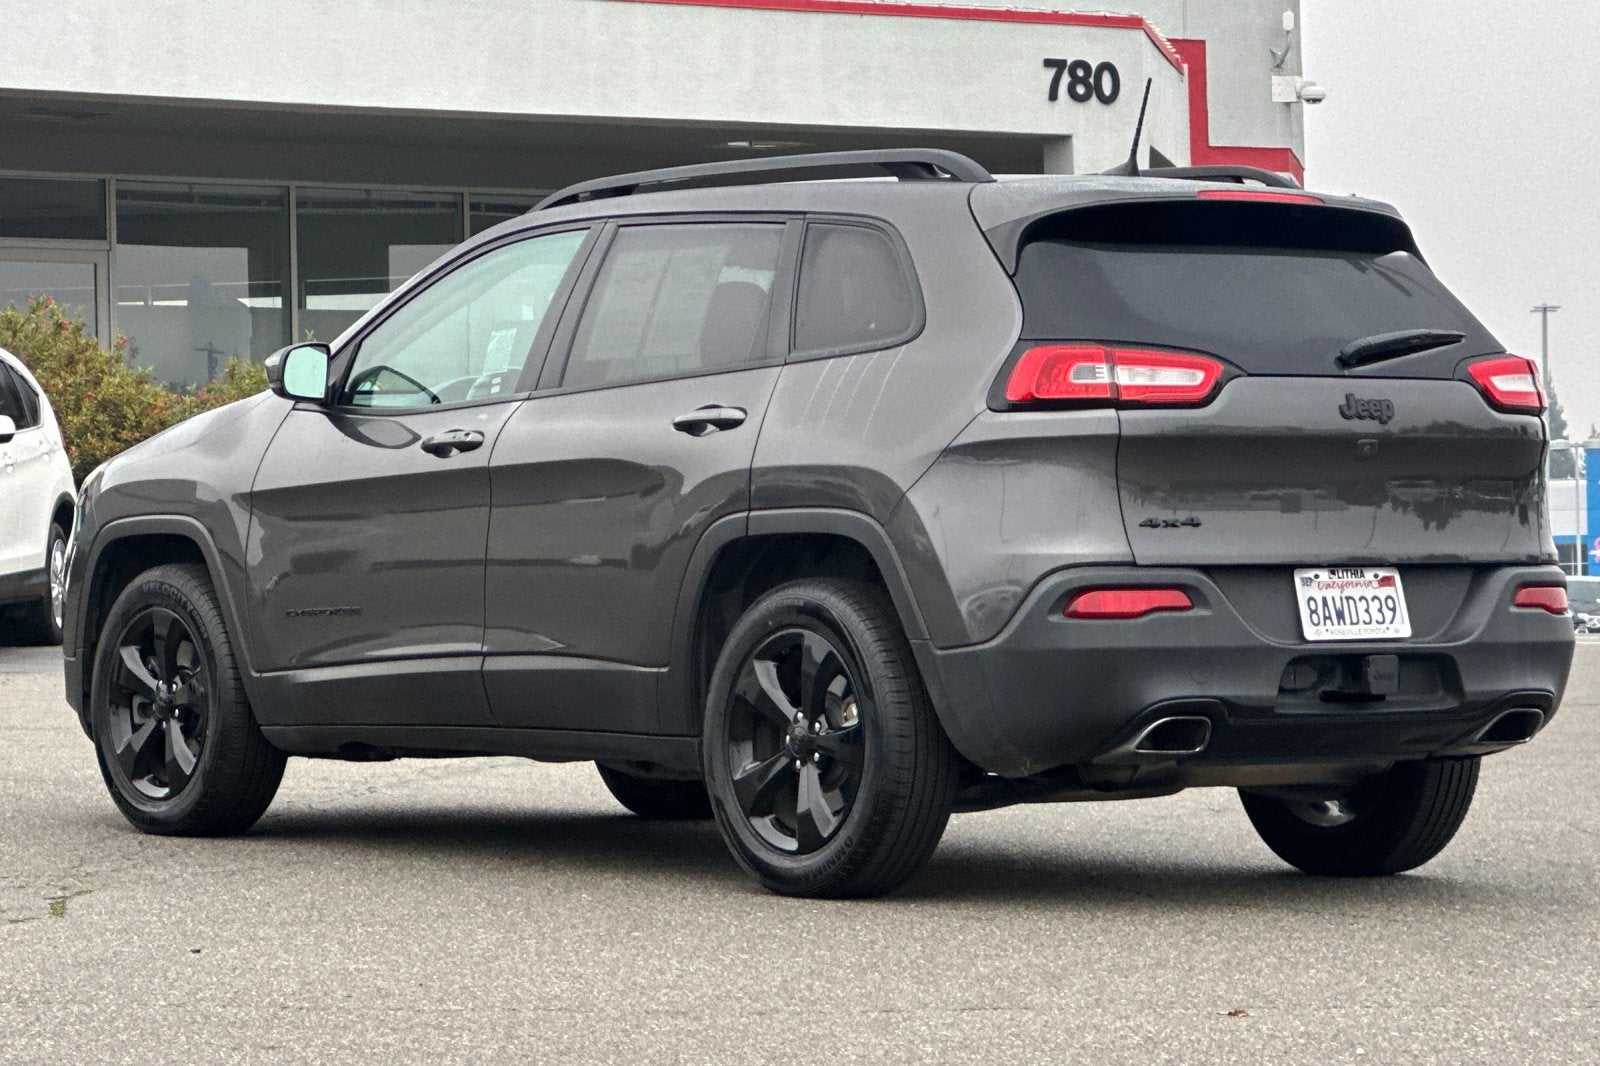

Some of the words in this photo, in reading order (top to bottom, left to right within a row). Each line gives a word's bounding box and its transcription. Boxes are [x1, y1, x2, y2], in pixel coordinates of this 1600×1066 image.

[1043, 58, 1120, 104] 780
[1339, 393, 1394, 425] Jeep
[1336, 569, 1366, 579] LITHIA
[1317, 580, 1380, 594] California
[1307, 595, 1397, 626] 8AWD339
[1363, 628, 1387, 636] TOYOTA
